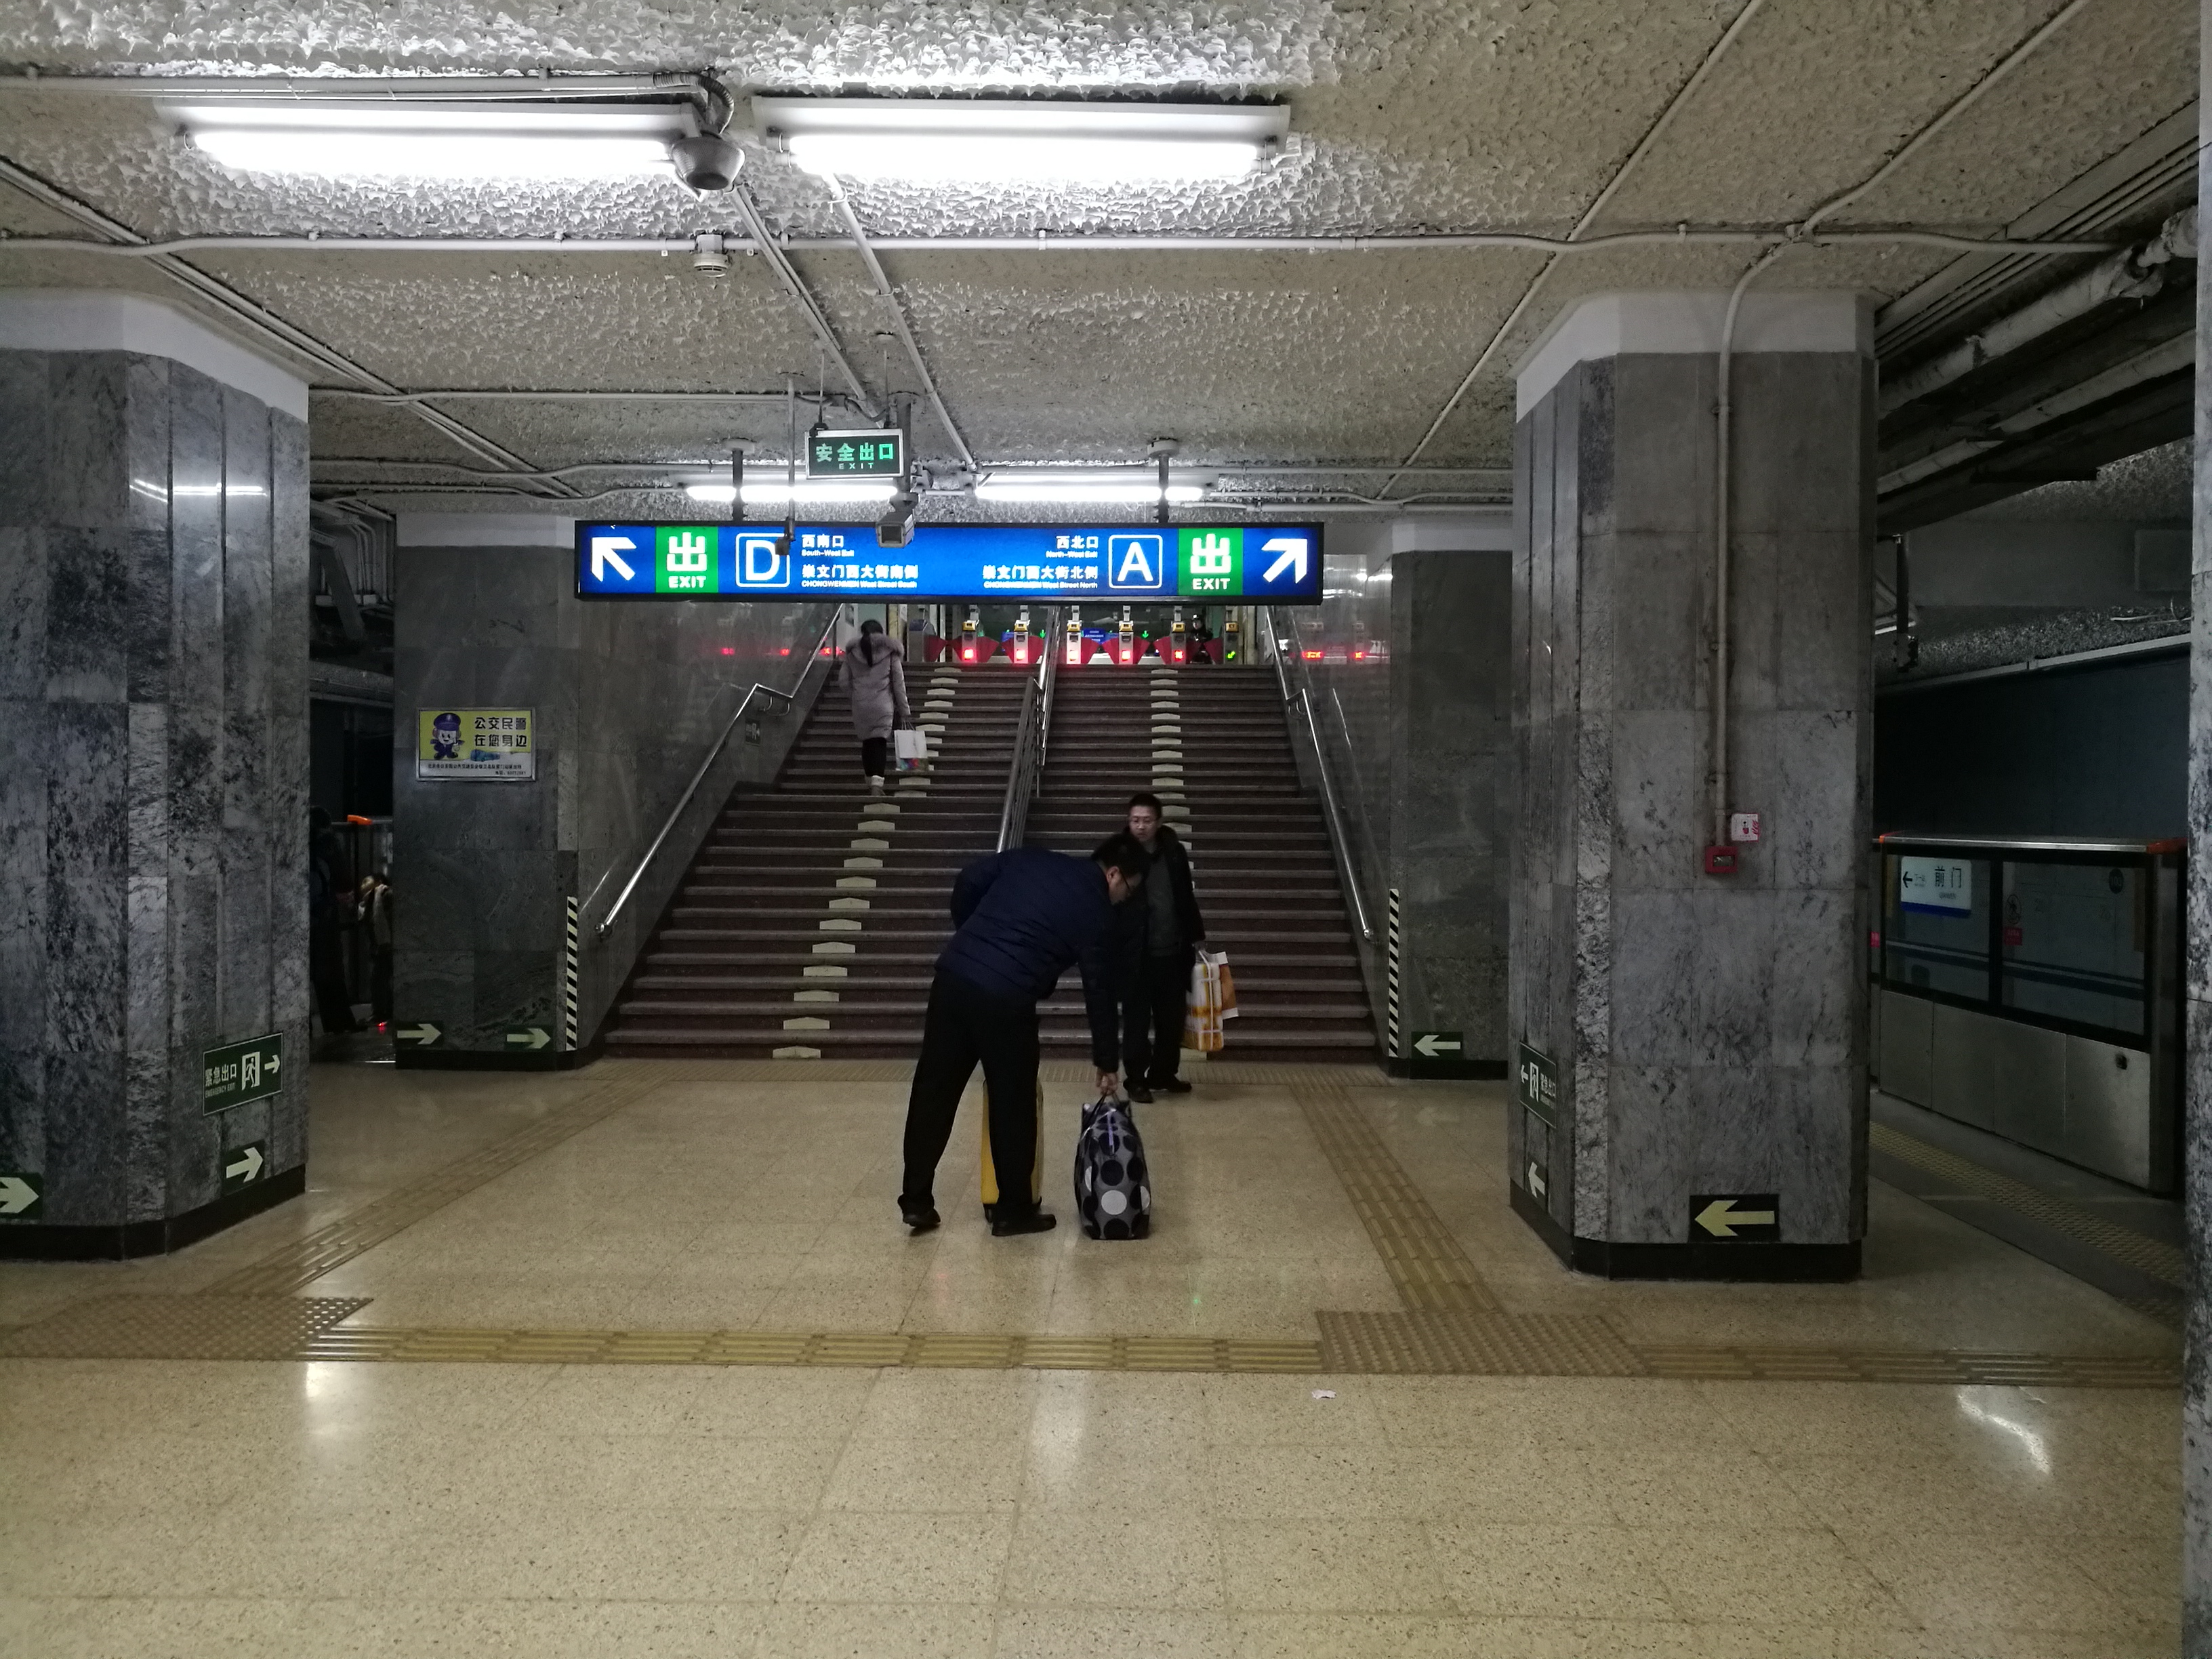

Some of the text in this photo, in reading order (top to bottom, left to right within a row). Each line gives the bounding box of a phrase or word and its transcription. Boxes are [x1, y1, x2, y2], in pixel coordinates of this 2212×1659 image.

[816, 442, 894, 462] 安全出口
[802, 533, 844, 548] 西南口
[1056, 535, 1099, 549] 西北口
[667, 532, 708, 572] 出
[1190, 533, 1231, 573] 出
[745, 539, 781, 581] D
[1118, 541, 1153, 582] A
[802, 564, 919, 579] 崇文门西大街南侧
[983, 565, 1099, 579] 崇文门西大街北侧
[668, 575, 707, 588] EXIT
[1192, 577, 1231, 590] EXIT
[474, 717, 527, 731] 公交民警
[474, 734, 527, 747] 在您身边
[1935, 866, 1962, 888] 前门
